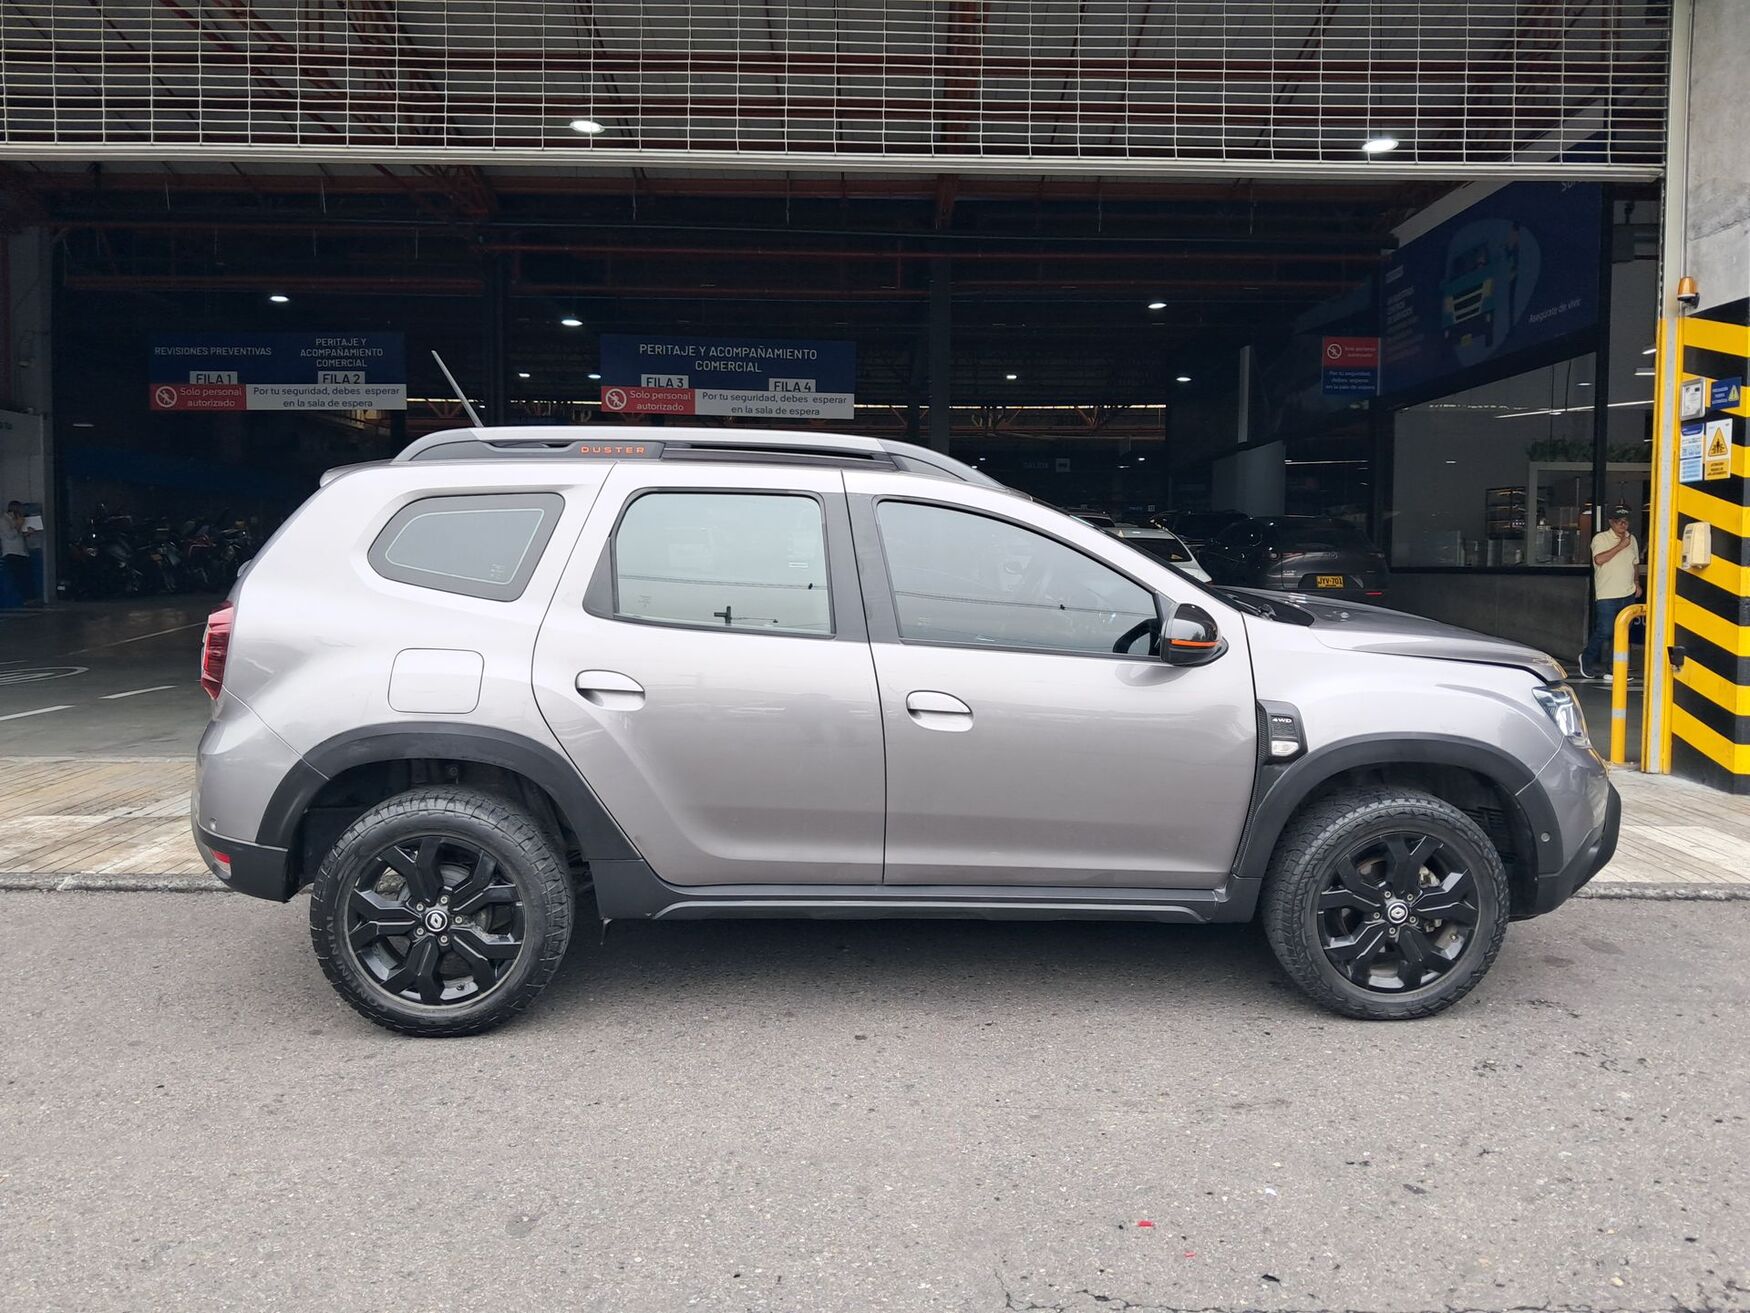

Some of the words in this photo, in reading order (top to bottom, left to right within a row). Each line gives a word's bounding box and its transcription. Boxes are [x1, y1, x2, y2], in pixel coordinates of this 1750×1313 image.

[315, 338, 360, 346] PERITAJE
[361, 338, 367, 346] Y
[154, 346, 208, 356] REVISIONES
[210, 346, 272, 356] PREVENTIVAS
[300, 347, 383, 357] ACOMPAÑAMIENTO
[639, 344, 696, 356] PERITAJE
[699, 346, 706, 356] Y
[709, 346, 817, 360] ACOMPAÑAMIENTO
[316, 359, 367, 367] COMERCIAL
[695, 360, 763, 373] COMERCIAL
[196, 374, 224, 384] FILA
[227, 374, 231, 384] 1
[322, 374, 350, 384] FILA
[353, 374, 360, 384] 2
[646, 377, 674, 388] FILA
[677, 378, 684, 388] 3
[774, 381, 801, 392] FILA
[804, 382, 811, 392] 4
[180, 387, 201, 395] Solo
[202, 387, 242, 398] personal
[253, 387, 269, 395] Por
[271, 387, 279, 395] tu
[281, 387, 330, 398] seguridad,
[332, 387, 360, 395] debes
[365, 388, 400, 397] esperar
[630, 390, 651, 399] Solo
[652, 391, 691, 401] personal
[702, 392, 717, 400] Por
[730, 393, 778, 403] seguridad,
[780, 394, 808, 403] debes
[812, 396, 847, 405] esperar
[298, 399, 305, 408] la
[307, 399, 326, 408] sala
[327, 399, 340, 408] de
[341, 400, 373, 410] espera
[637, 403, 684, 411] autorizado
[745, 406, 753, 414] la
[755, 406, 773, 415] sala
[775, 407, 786, 415] de
[789, 408, 820, 417] espera
[580, 446, 645, 454] DUSTER
